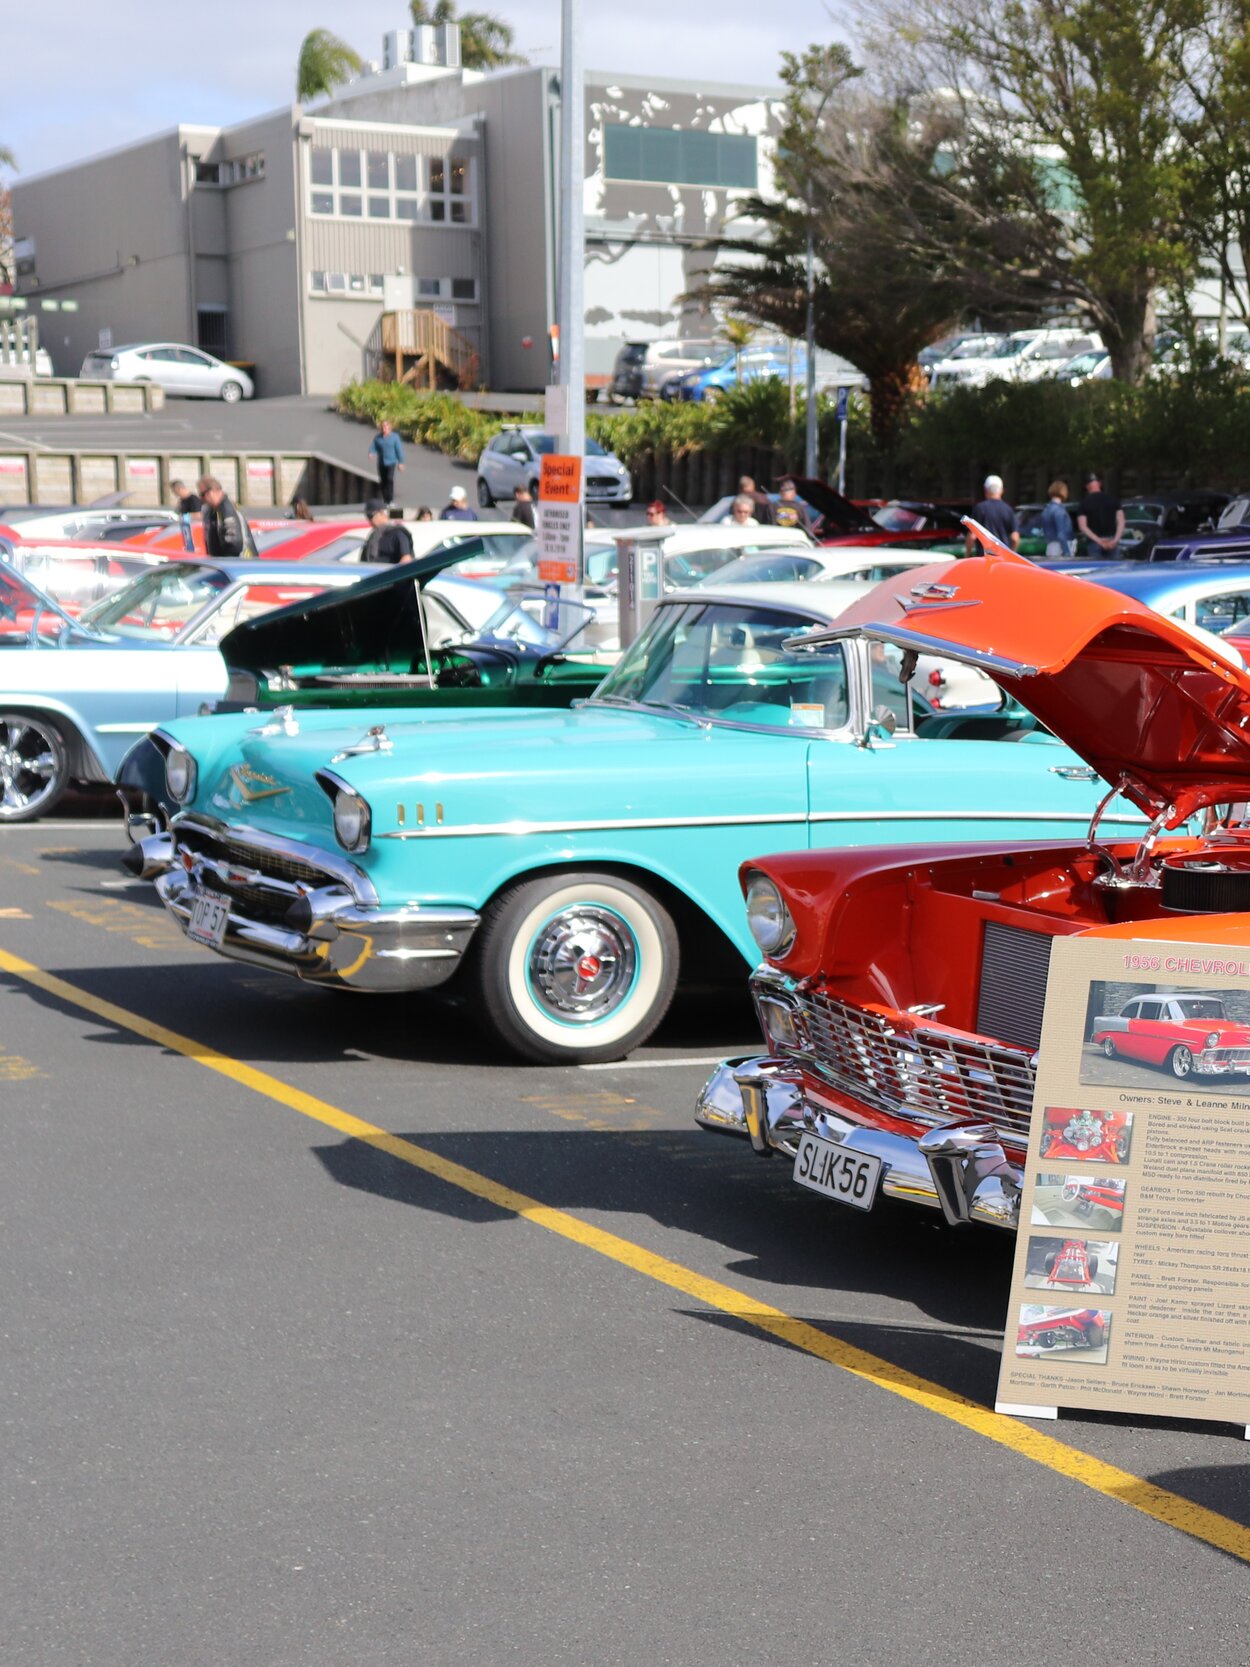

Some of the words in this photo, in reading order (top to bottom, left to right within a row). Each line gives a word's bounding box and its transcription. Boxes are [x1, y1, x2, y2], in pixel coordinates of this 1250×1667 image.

[543, 462, 574, 478] Special
[545, 481, 569, 495] Event
[210, 905, 227, 933] 57
[1122, 955, 1160, 970] 1956
[1119, 1094, 1155, 1104] Owners:
[1157, 1097, 1182, 1106] Steve
[1196, 1100, 1228, 1109] Leanne
